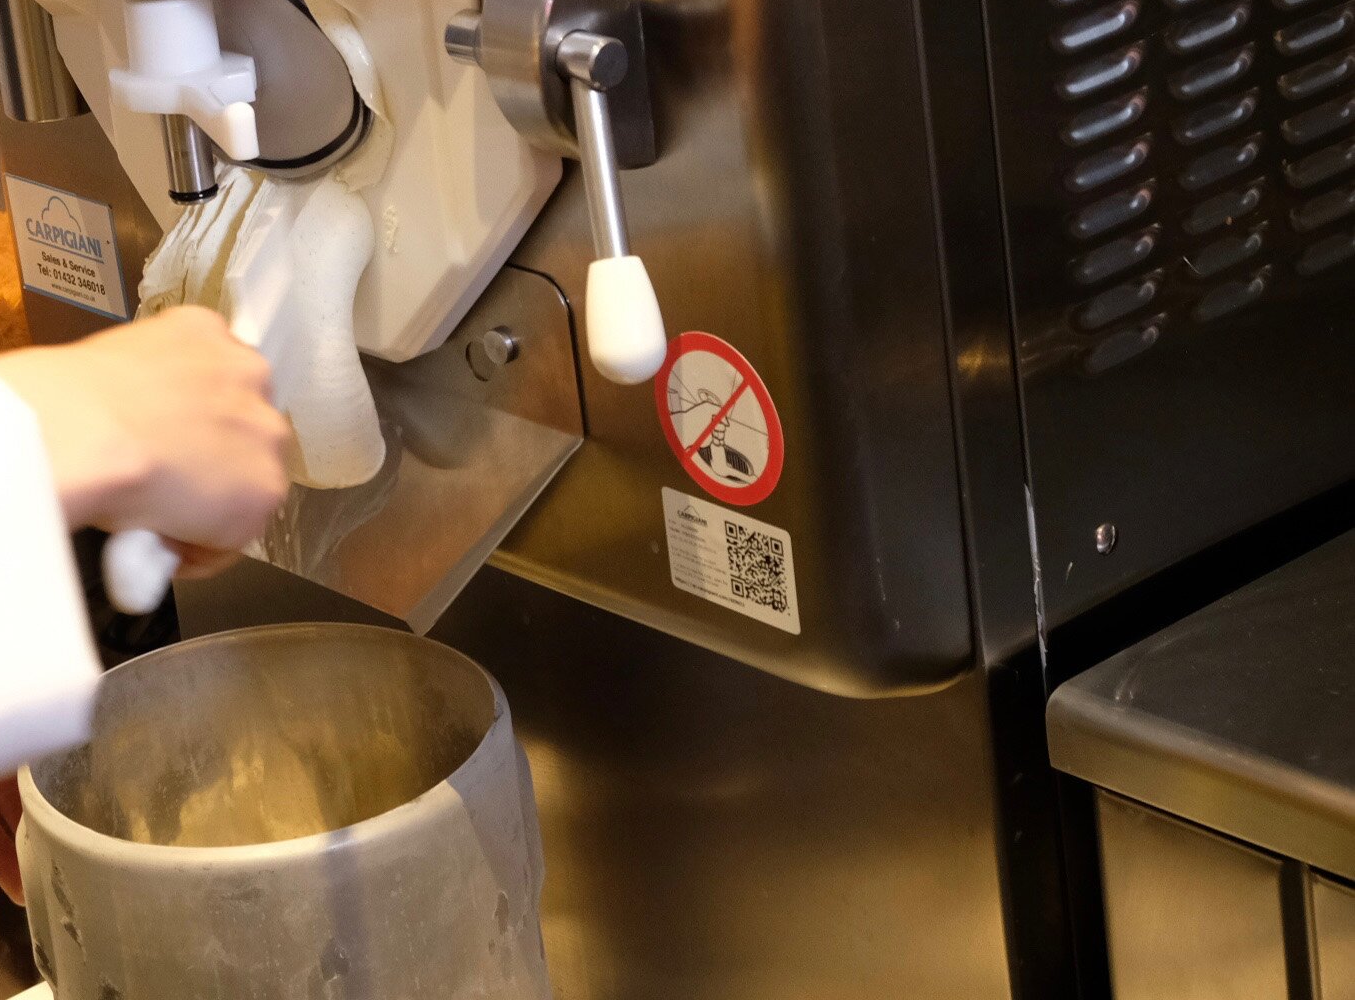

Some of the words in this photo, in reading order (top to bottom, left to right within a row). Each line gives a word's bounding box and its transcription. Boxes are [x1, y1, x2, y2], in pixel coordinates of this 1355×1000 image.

[26, 217, 103, 258] CARPIGIANI
[37, 263, 52, 277] Tel:
[53, 268, 77, 286] 01432
[41, 251, 61, 266] Sales
[62, 258, 68, 268] &
[68, 260, 96, 278] Service
